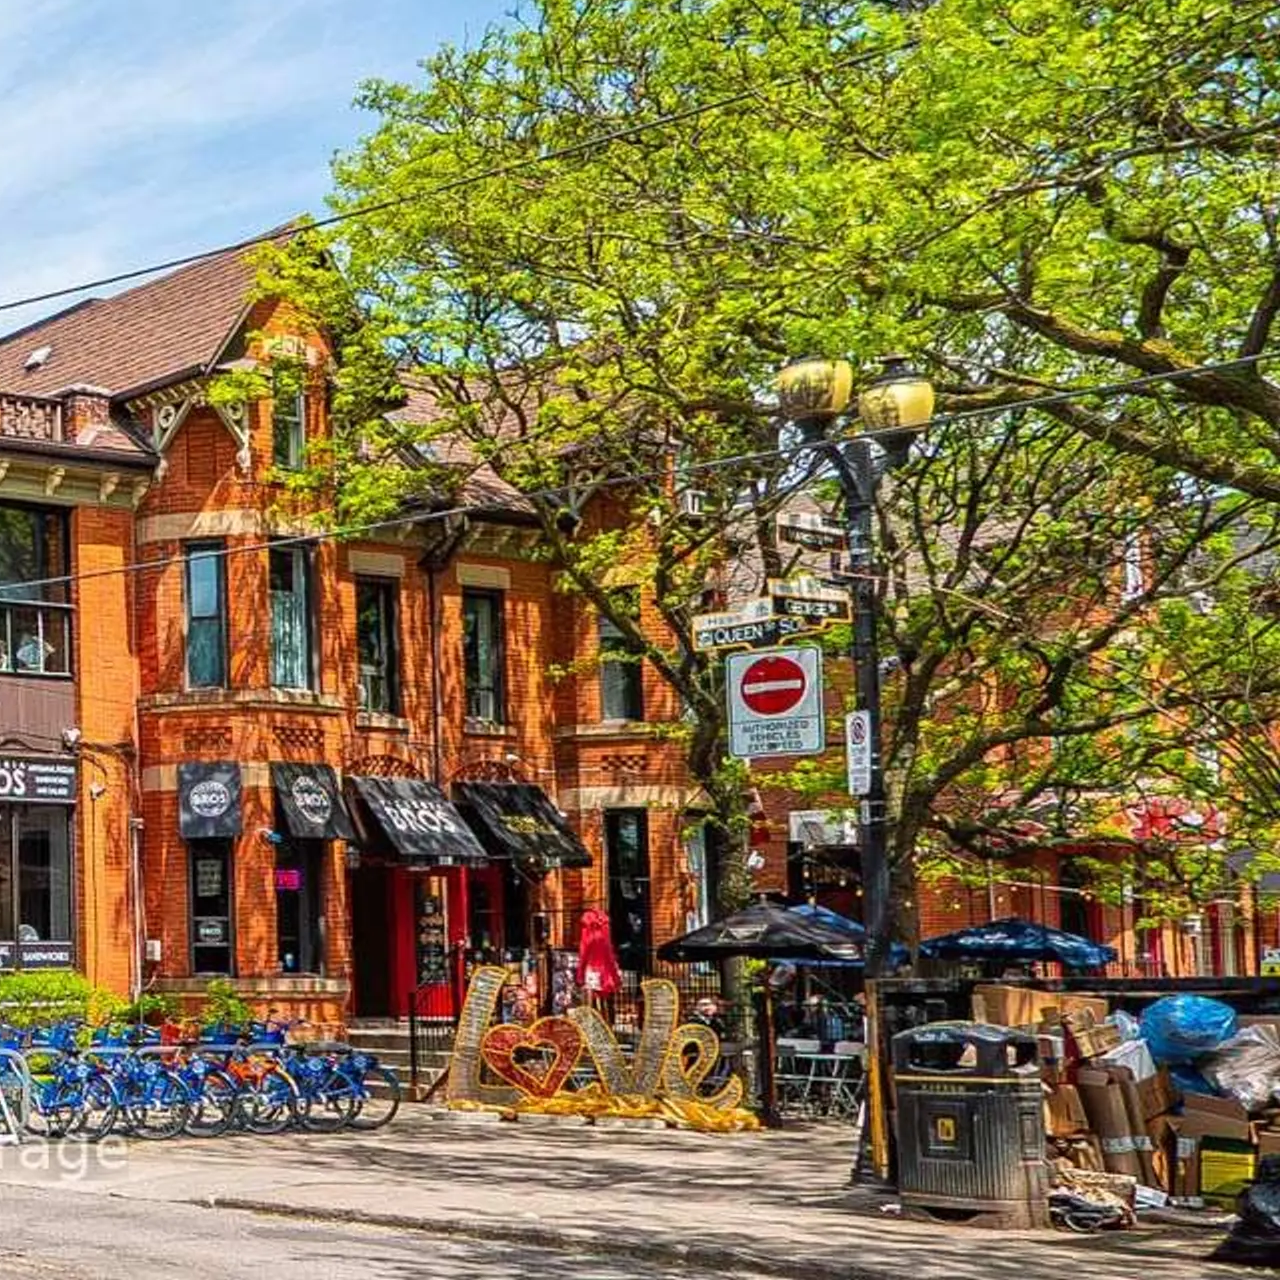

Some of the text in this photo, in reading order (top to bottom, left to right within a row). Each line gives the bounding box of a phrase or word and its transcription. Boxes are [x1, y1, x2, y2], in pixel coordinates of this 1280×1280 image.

[714, 624, 763, 644] QUEEN
[742, 720, 810, 733] AUTHORIZED
[750, 731, 800, 742] VEHICLES
[193, 793, 226, 805] BROS
[383, 806, 456, 833] BROS
[22, 951, 69, 961] SANDWICHES
